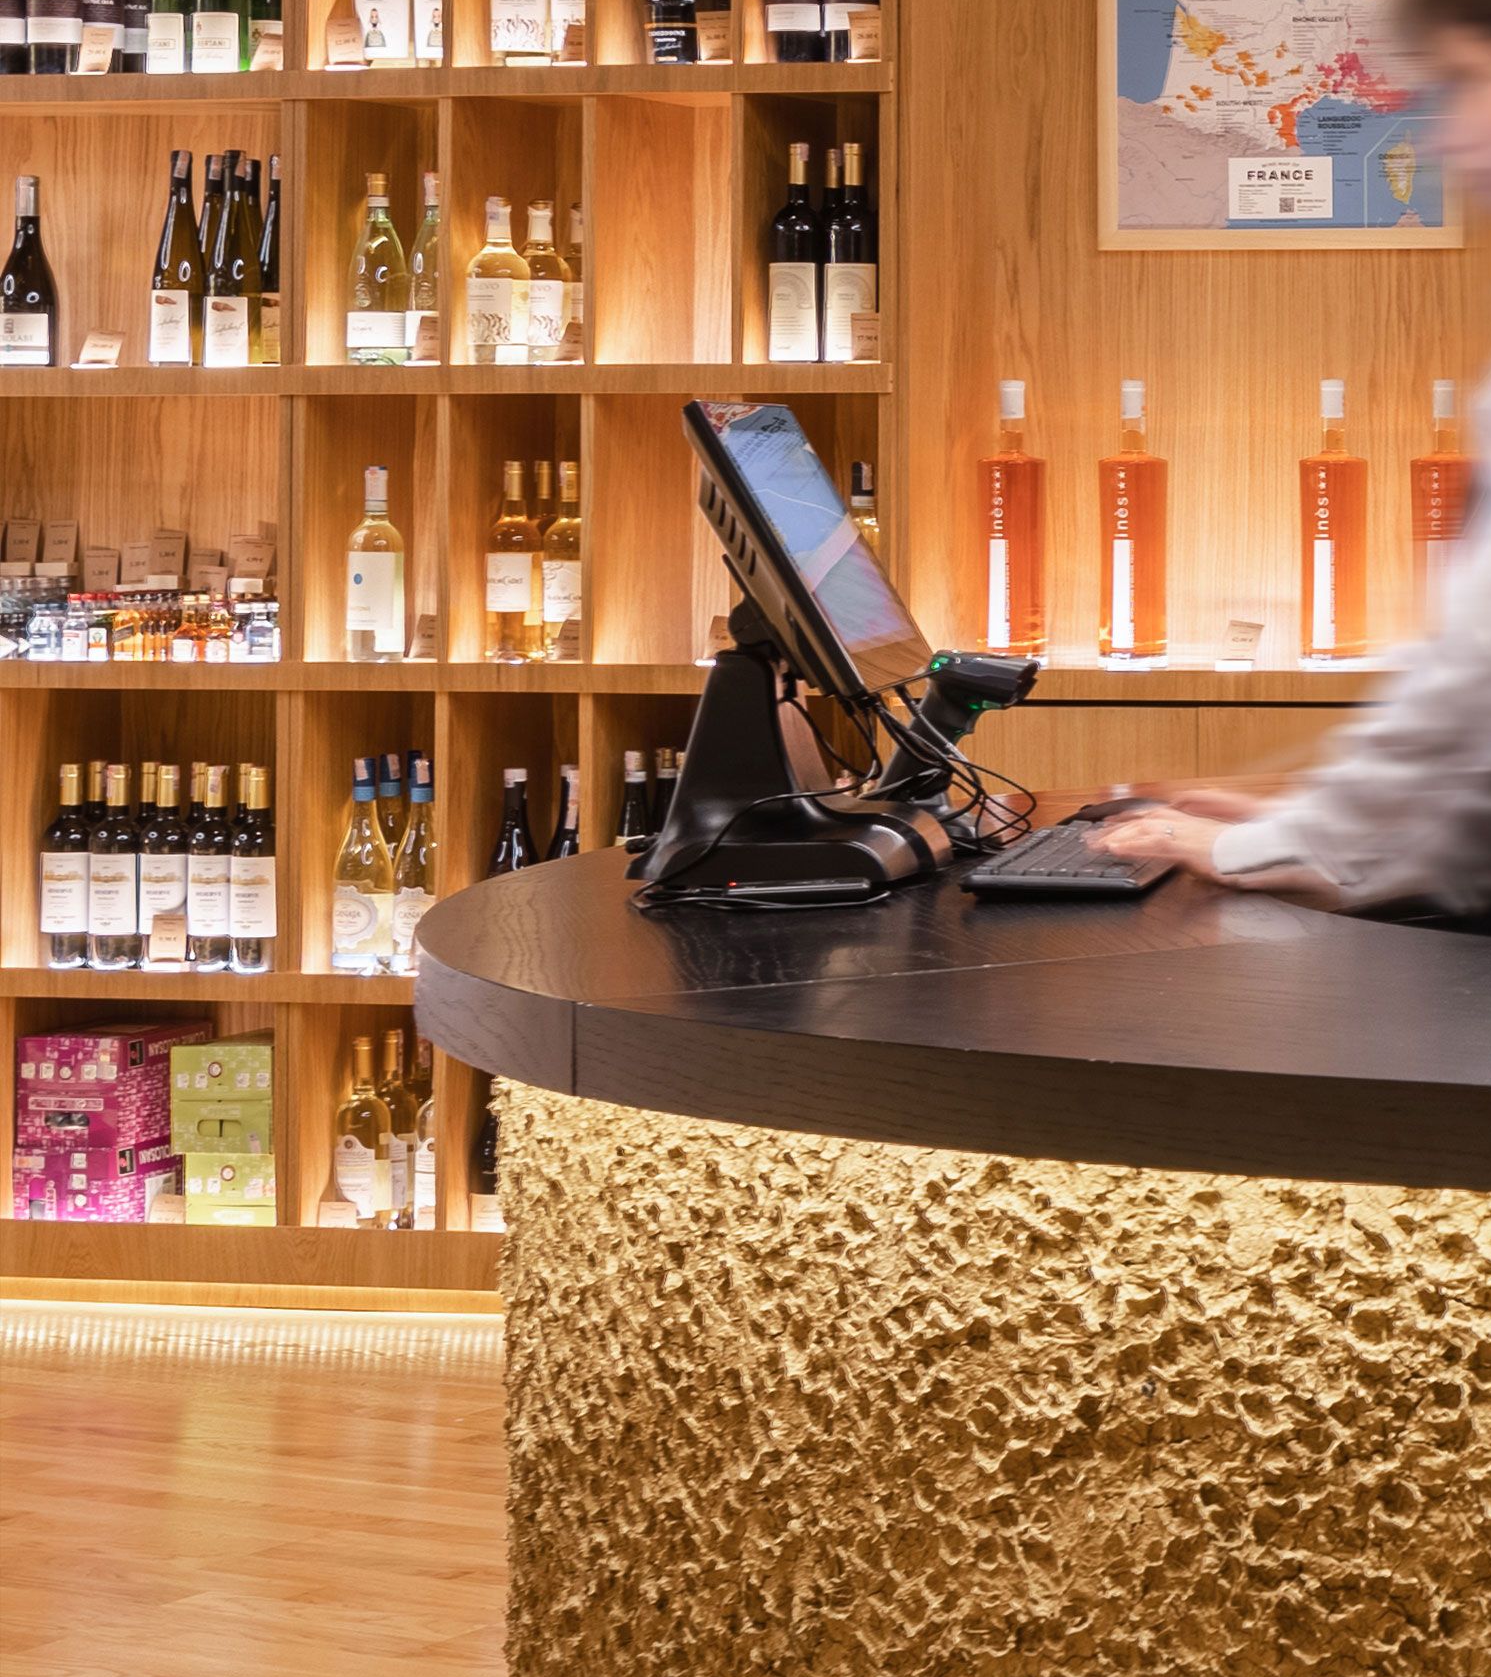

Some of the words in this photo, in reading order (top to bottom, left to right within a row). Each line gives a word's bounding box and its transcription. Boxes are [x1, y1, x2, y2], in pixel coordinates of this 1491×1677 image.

[1246, 169, 1314, 182] FRANCE
[1114, 496, 1129, 537] Inès
[1314, 496, 1330, 537] Inès
